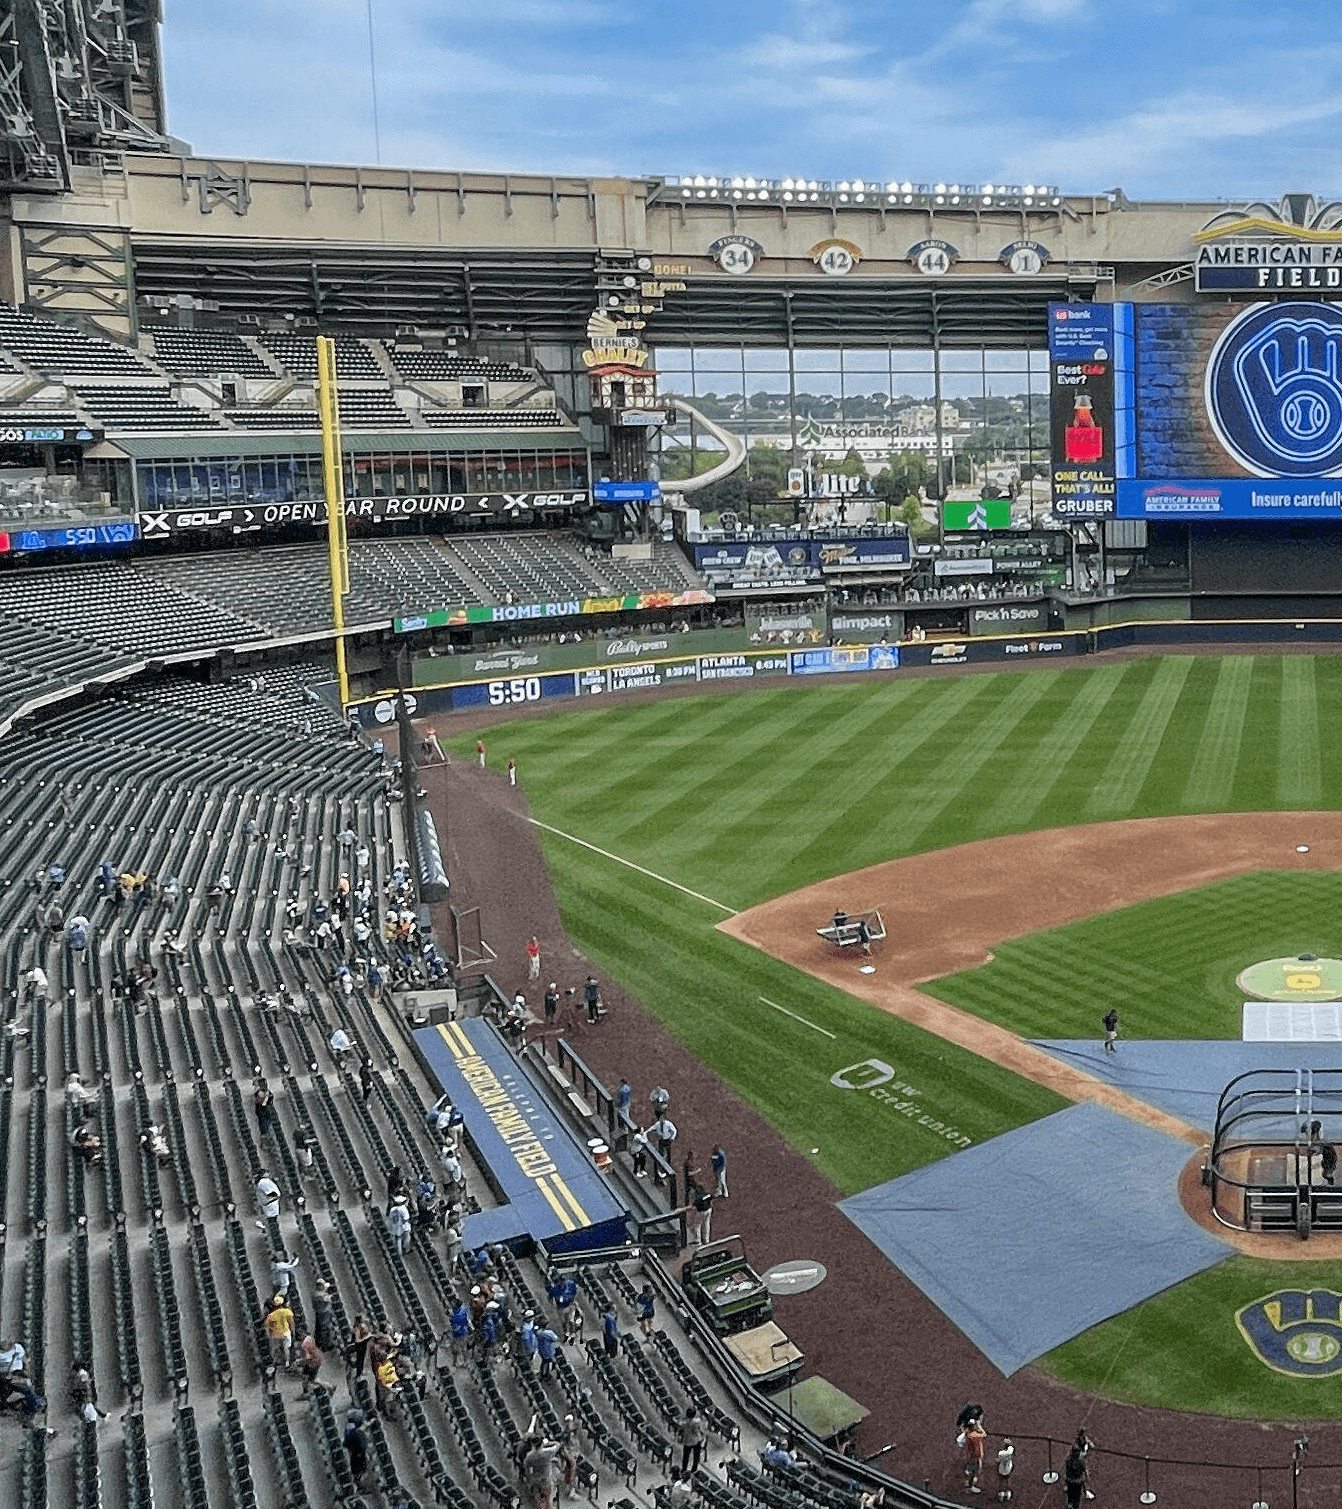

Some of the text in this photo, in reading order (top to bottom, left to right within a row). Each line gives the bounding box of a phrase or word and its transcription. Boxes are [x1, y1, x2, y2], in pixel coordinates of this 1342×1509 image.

[725, 250, 750, 267] 34
[824, 252, 850, 269] 42
[922, 253, 946, 271] 44
[1199, 246, 1312, 264] AMERICAN
[1258, 268, 1340, 287] FIELD
[592, 338, 639, 348] BERNIE'S
[1057, 365, 1082, 374] Best
[1057, 375, 1088, 385] Ever?
[823, 425, 931, 438] Associated Bank
[1054, 471, 1078, 481] ONE
[1054, 483, 1115, 494] THAT'S ALL!
[1056, 500, 1114, 512] GRUBER
[1145, 496, 1220, 505] AMERICAN FAMILY
[1251, 490, 1291, 507] Insure
[142, 513, 171, 533] X
[176, 510, 233, 528] GOLF
[263, 503, 317, 522] OPEN
[324, 500, 373, 517] YAR
[385, 496, 466, 514] ROUND
[502, 494, 530, 509] X
[533, 493, 586, 506] GOLF
[996, 561, 1020, 569] POWER
[1021, 560, 1042, 568] ALLEY
[492, 602, 542, 621] HOME
[549, 601, 581, 617] RUN
[1010, 608, 1040, 620] Save
[841, 615, 892, 630] impact
[607, 640, 668, 656] Bally SPORTS
[701, 656, 746, 668] ATLANTA
[613, 664, 656, 678] TORONTO
[613, 675, 662, 690] LA ANGELS
[488, 678, 542, 706] 5:50
[455, 1054, 558, 1179] AMERICAN FAMILY FIELD
[870, 1088, 972, 1148] credit union
